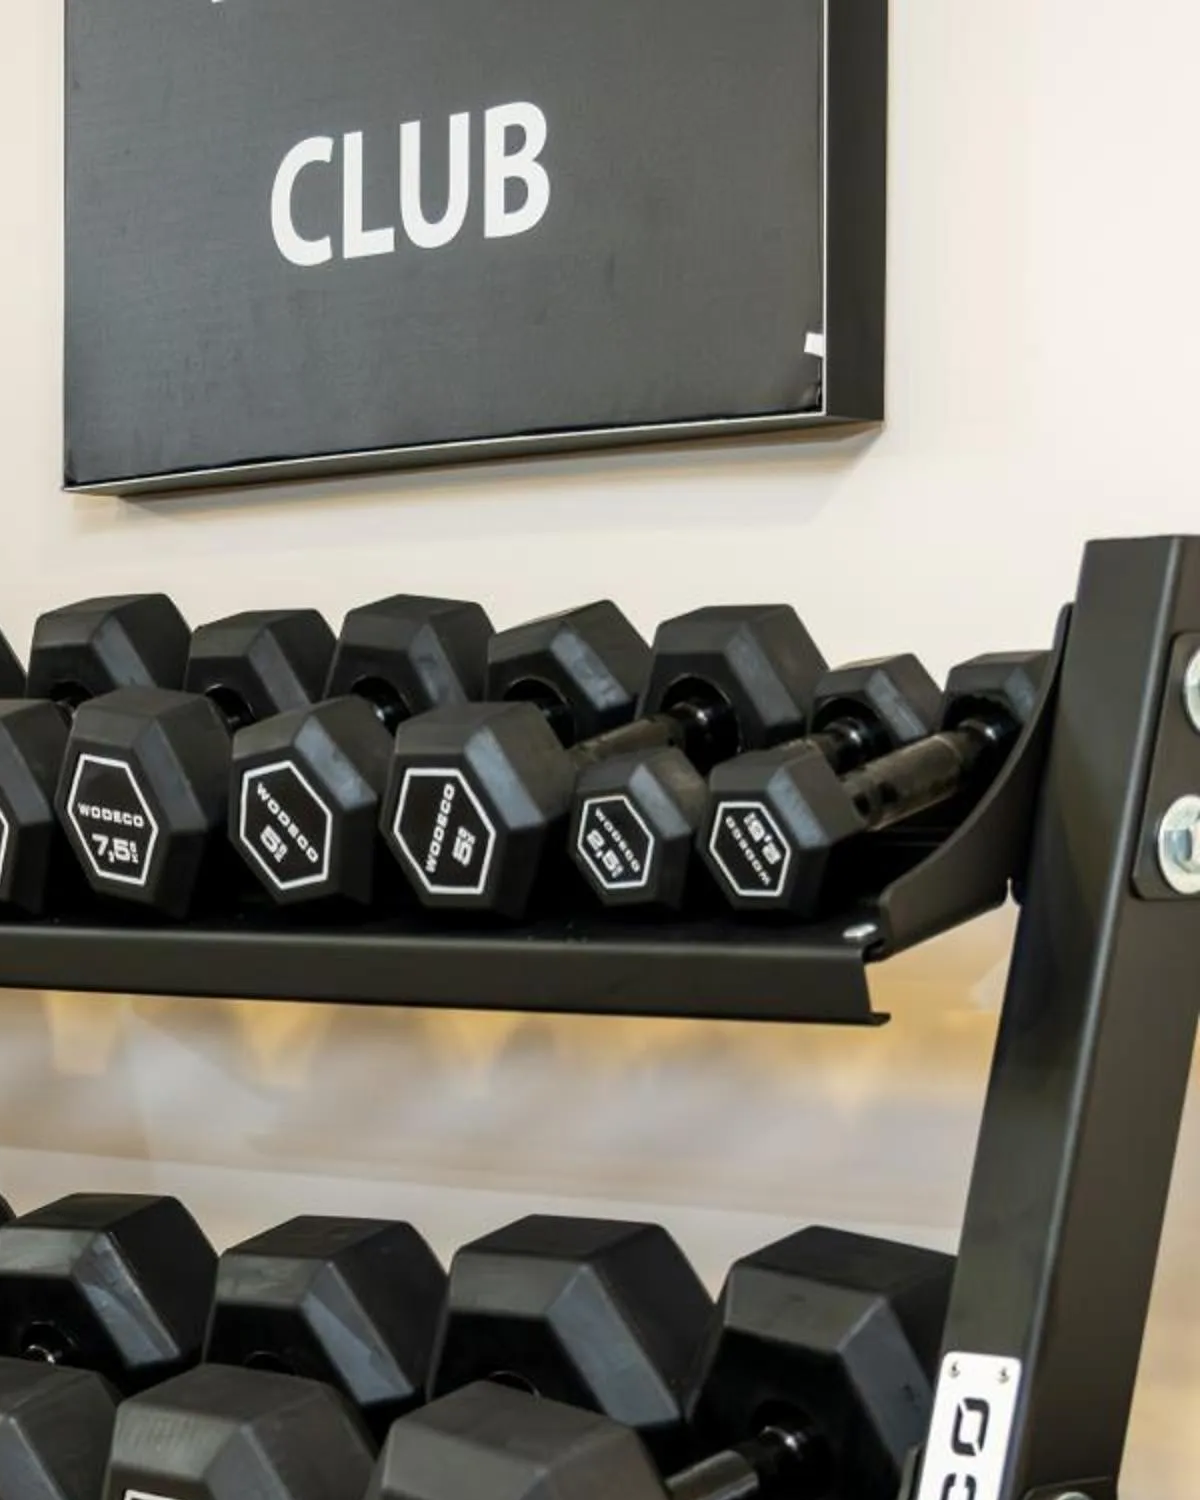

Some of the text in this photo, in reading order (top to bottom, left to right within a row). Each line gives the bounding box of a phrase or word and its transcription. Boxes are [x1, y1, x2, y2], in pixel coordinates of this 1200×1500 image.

[269, 101, 551, 266] CLUB
[77, 802, 145, 828] WODECO
[256, 782, 319, 864] WODECO
[424, 783, 456, 873] WODECO
